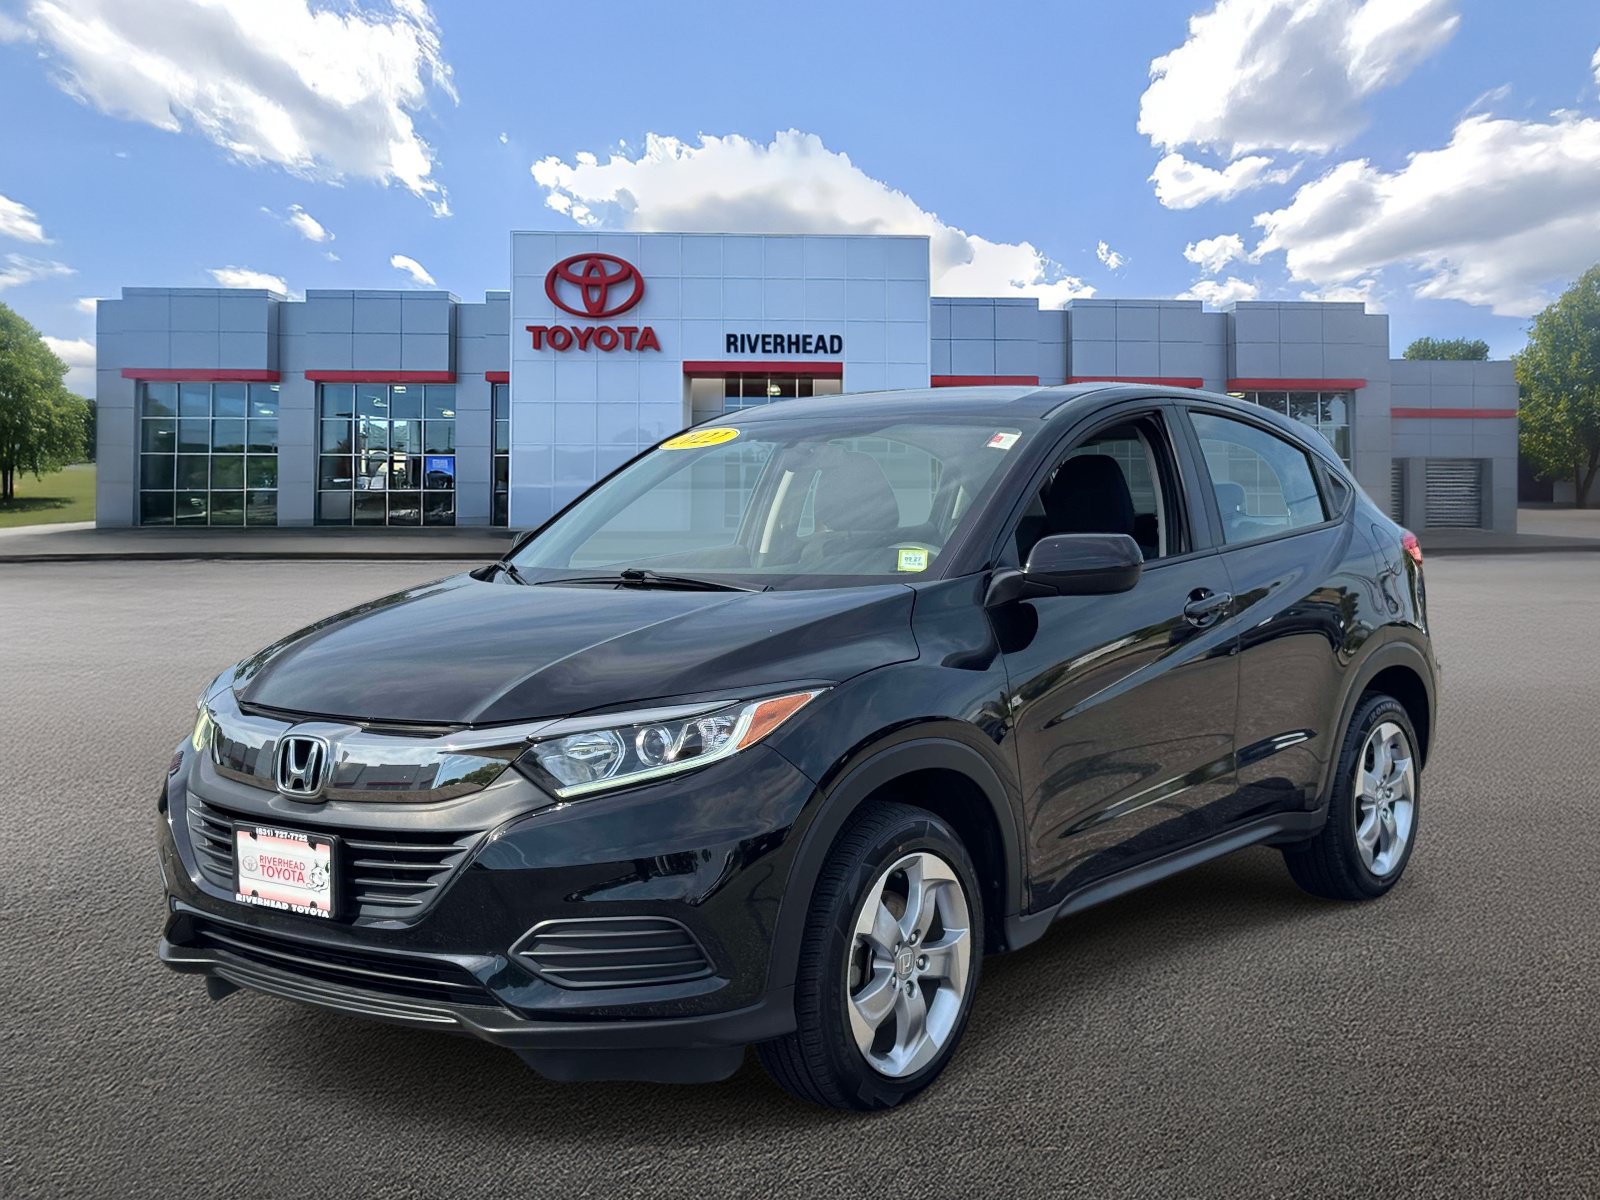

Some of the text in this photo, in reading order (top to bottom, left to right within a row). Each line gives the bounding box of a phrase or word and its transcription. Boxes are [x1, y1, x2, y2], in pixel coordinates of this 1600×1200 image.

[525, 325, 661, 352] TOYOTA
[725, 333, 844, 354] RIVERHEAD
[259, 855, 305, 871] RIVERHEAD
[260, 864, 305, 884] TOYOTA
[235, 893, 330, 919] RIVERHEAD TOYOTA
